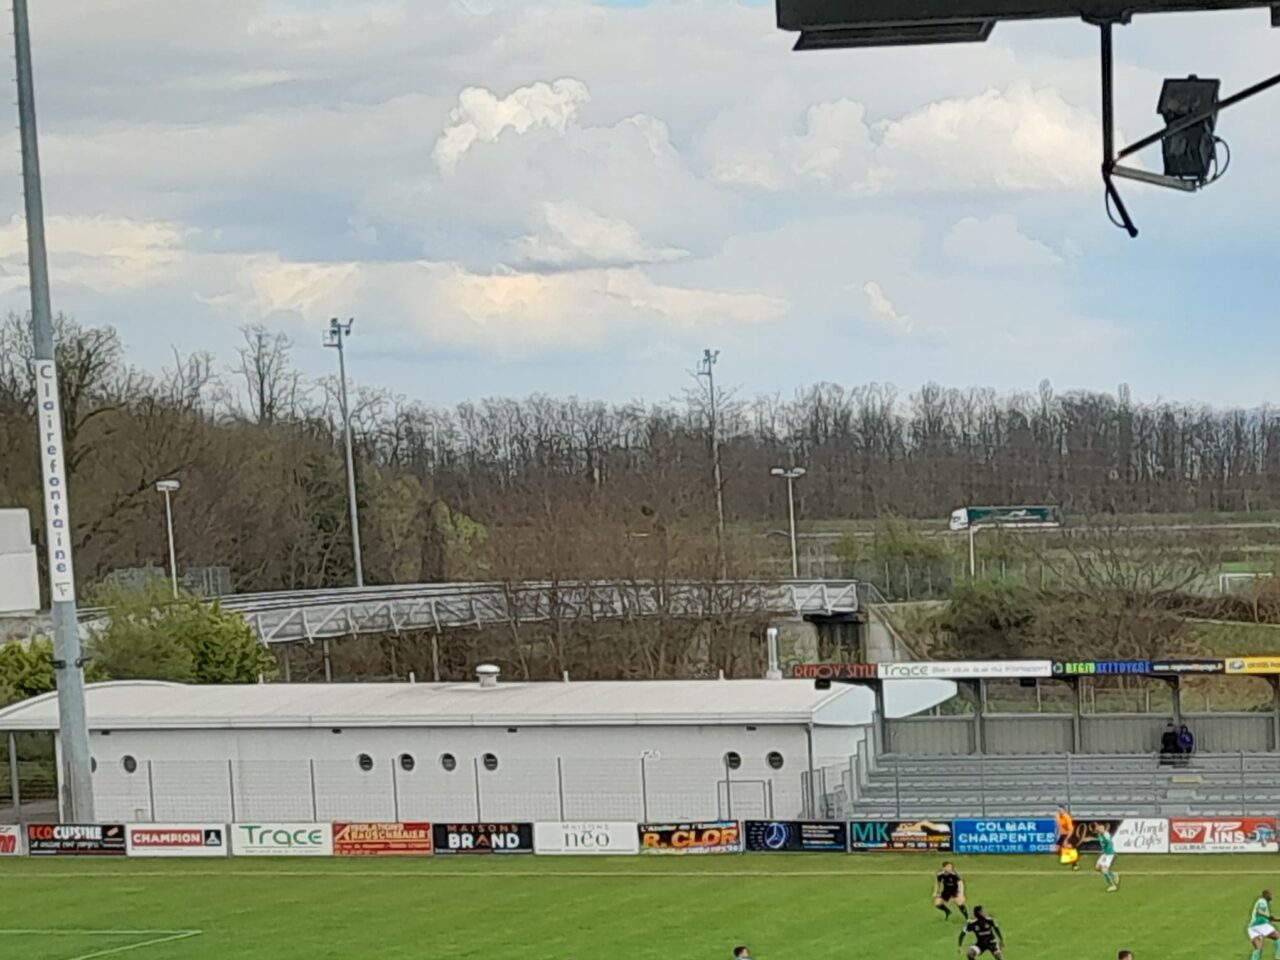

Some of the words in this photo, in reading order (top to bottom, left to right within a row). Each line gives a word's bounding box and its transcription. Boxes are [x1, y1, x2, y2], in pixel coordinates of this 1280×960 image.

[40, 365, 68, 573] Clairefontaine
[881, 664, 929, 678] Trace
[852, 823, 888, 843] MK
[975, 822, 1036, 832] COLMAR
[133, 832, 201, 844] CHAMPION
[238, 825, 323, 847] Trace
[448, 833, 519, 849] BRAND
[671, 829, 738, 848] CLOR
[958, 832, 1056, 843] CHARPENTES
[958, 844, 1025, 852] STRUCTURE
